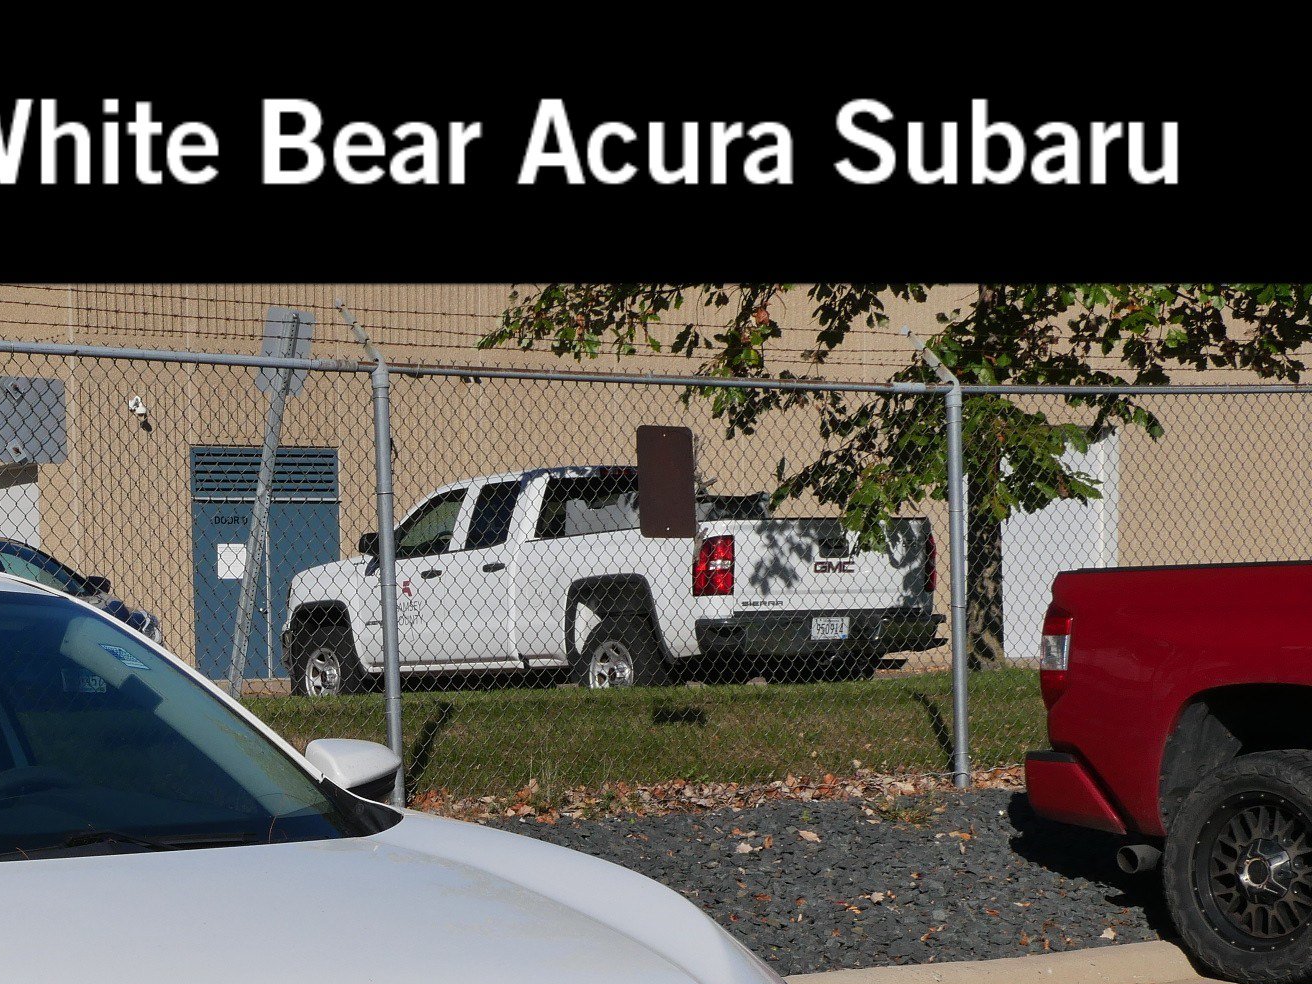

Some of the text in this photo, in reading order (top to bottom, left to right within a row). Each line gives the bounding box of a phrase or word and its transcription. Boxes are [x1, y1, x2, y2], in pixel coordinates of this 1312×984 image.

[214, 515, 240, 524] DOOR
[813, 561, 855, 574] GMC
[397, 600, 423, 612] AMSEY
[398, 614, 424, 626] OUNTY
